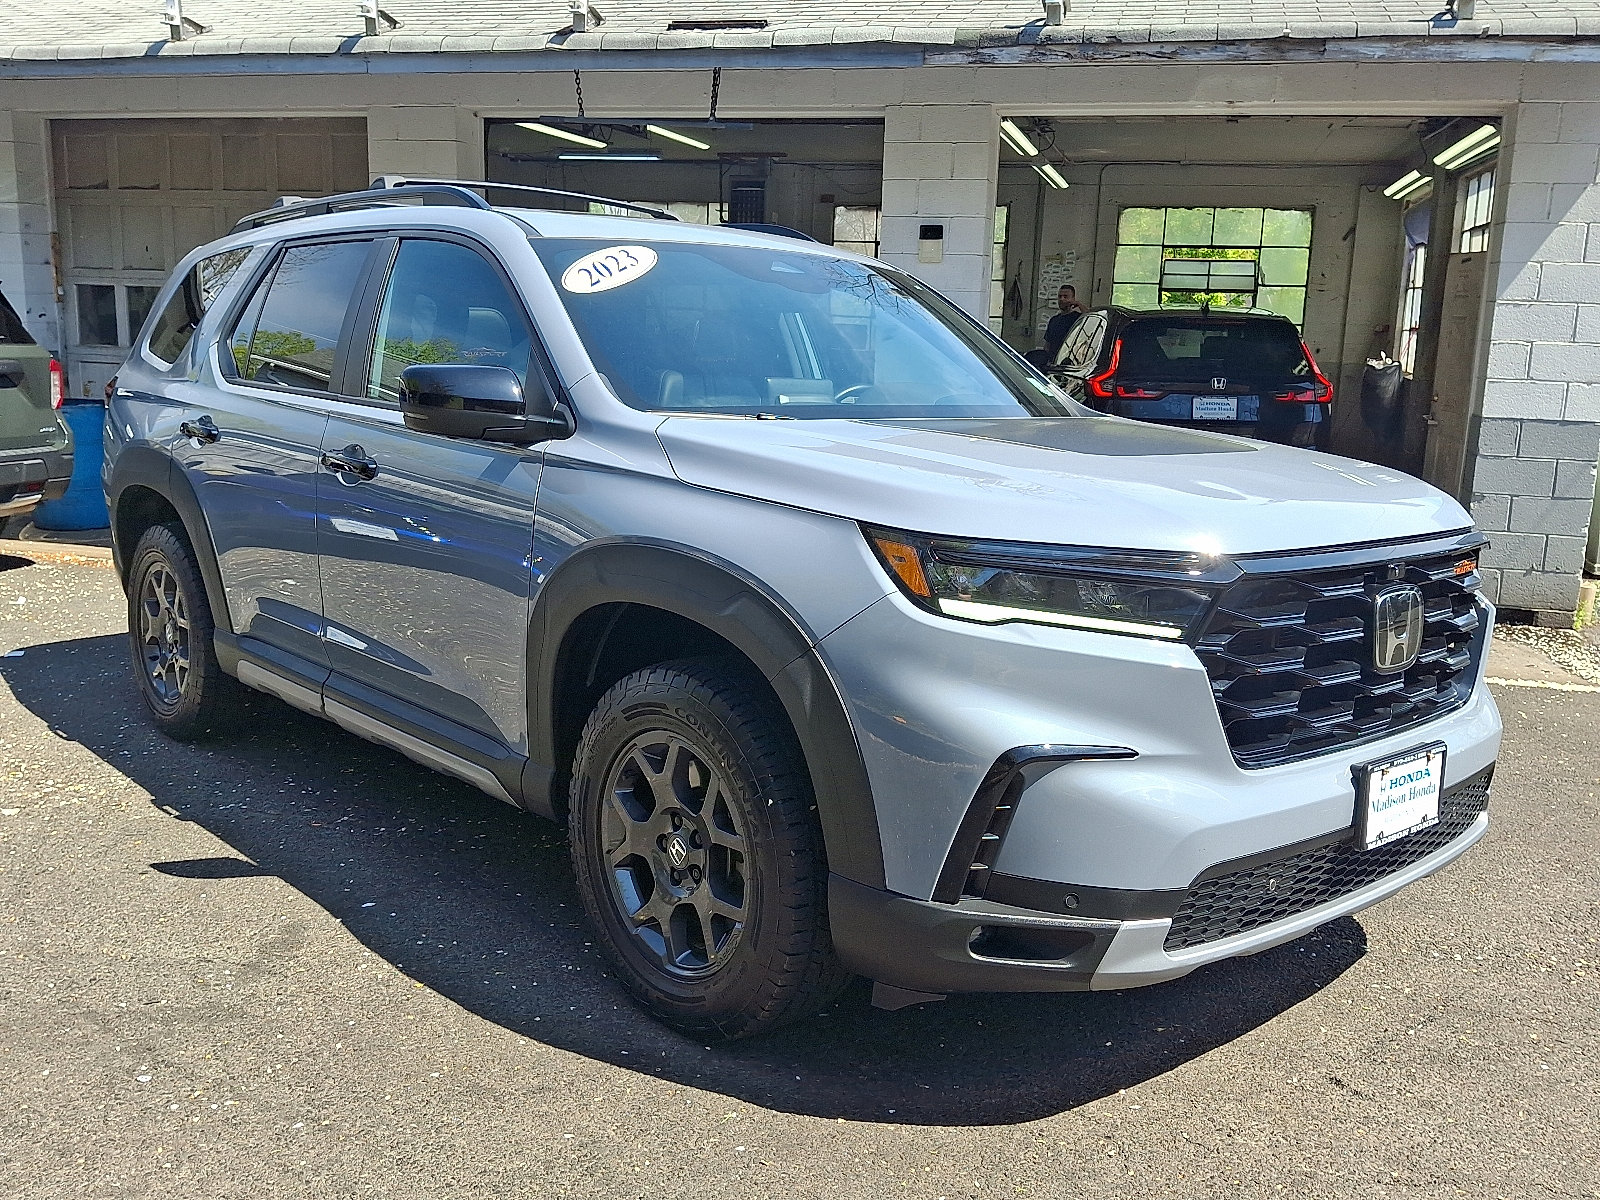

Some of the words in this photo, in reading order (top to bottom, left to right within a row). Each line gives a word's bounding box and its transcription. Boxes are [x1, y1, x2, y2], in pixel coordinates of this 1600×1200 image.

[577, 249, 639, 288] 2023
[1389, 768, 1431, 790] HONDA
[1371, 794, 1406, 813] Madison
[1408, 781, 1436, 801] Honda
